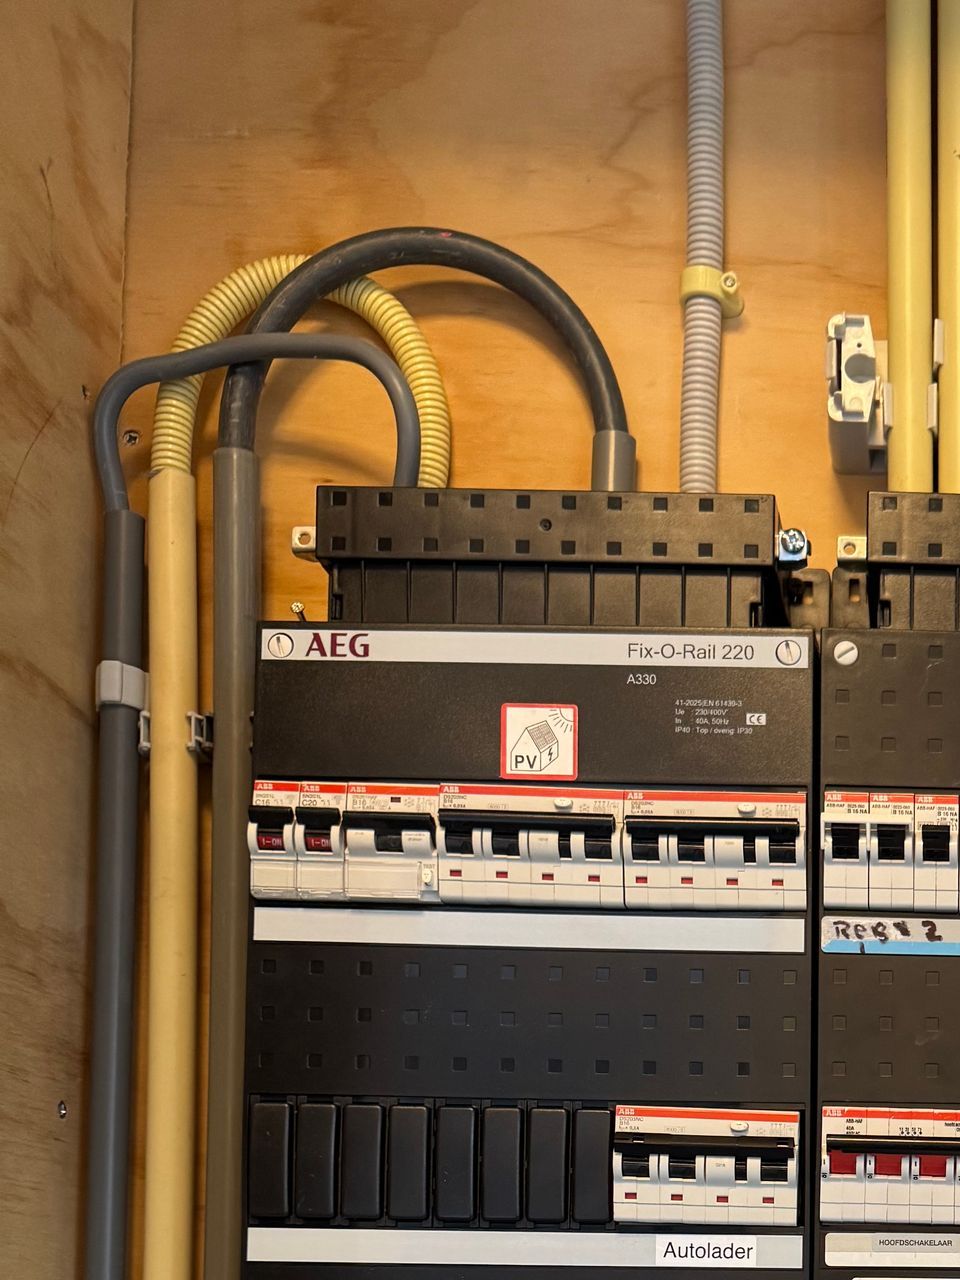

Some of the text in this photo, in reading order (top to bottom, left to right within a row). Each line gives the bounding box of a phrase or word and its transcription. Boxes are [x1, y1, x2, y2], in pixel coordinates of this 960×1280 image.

[305, 632, 371, 659] AEG
[627, 641, 756, 661] Fix-O-Rail 220
[626, 672, 657, 686] A330
[514, 754, 538, 770] PV
[663, 1241, 754, 1260] Autolader
[879, 1239, 953, 1247] HOOFDSCHAKELAAR
